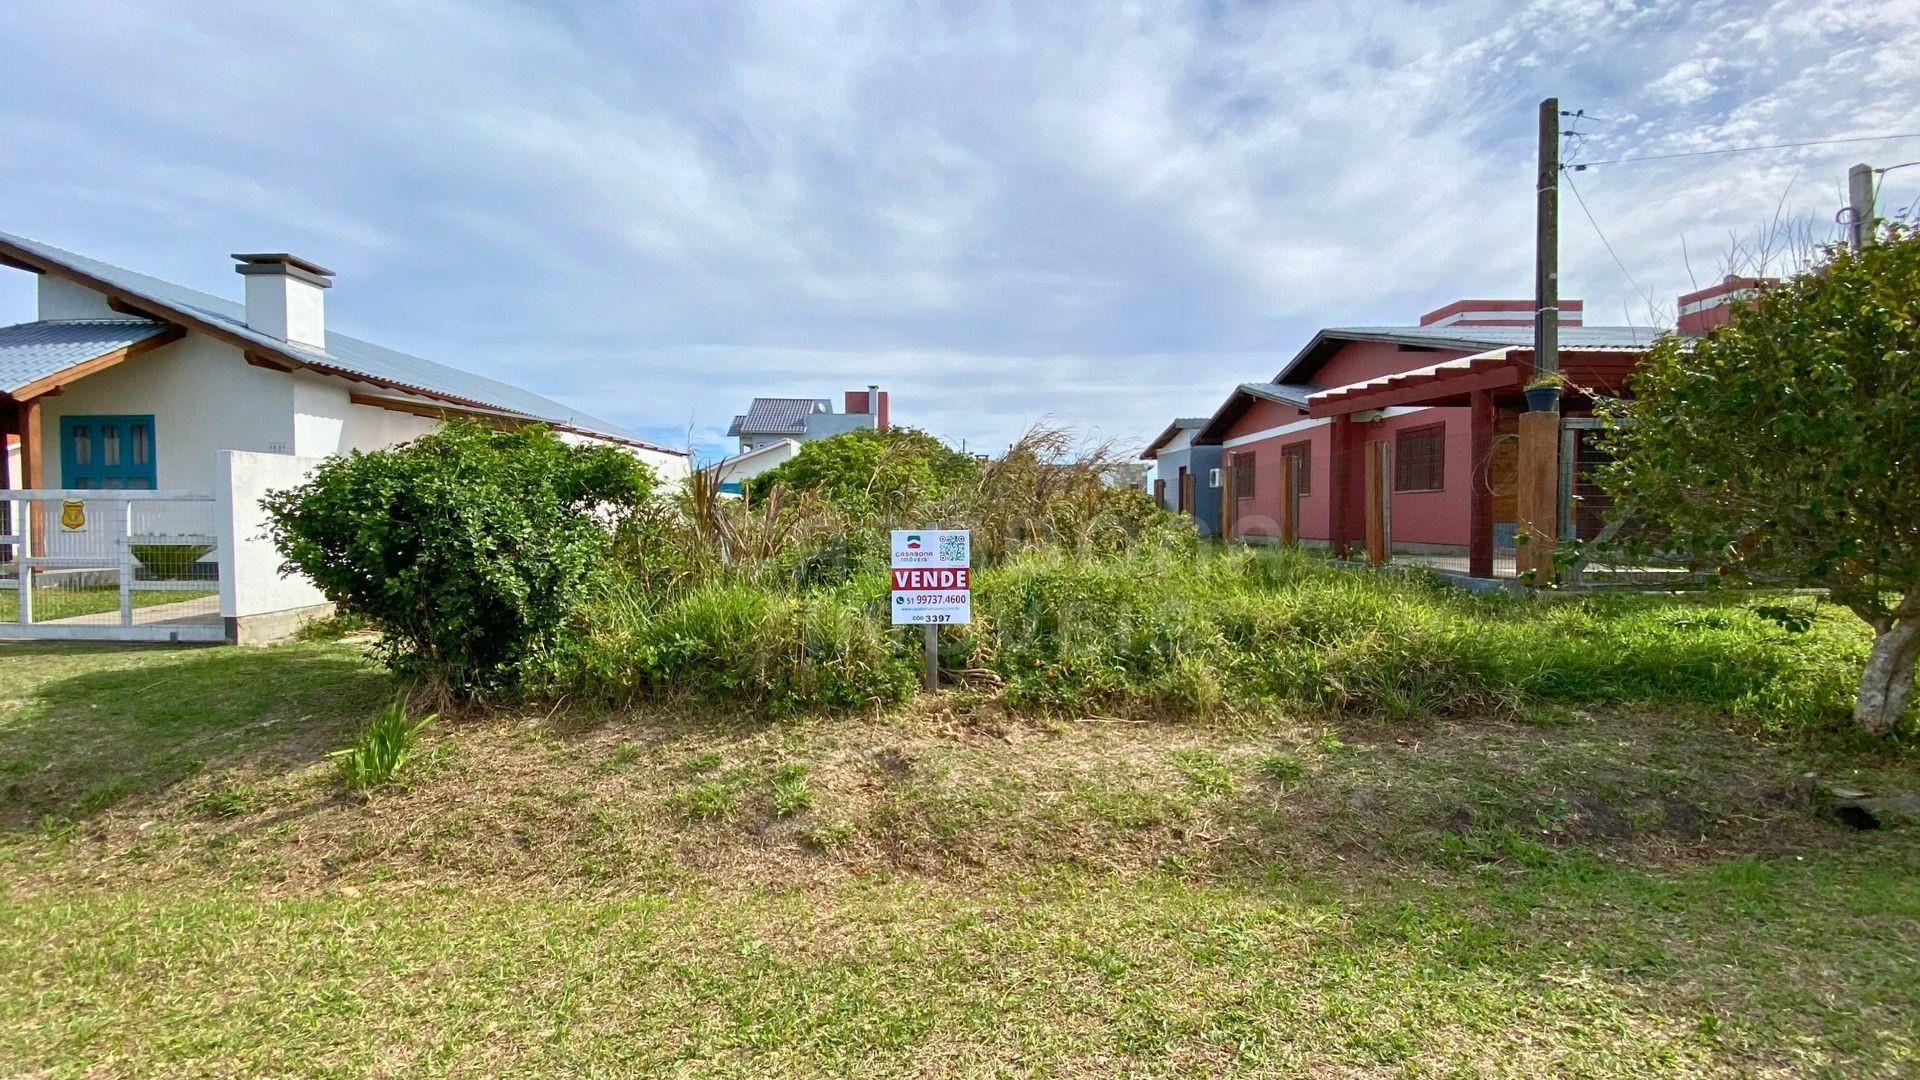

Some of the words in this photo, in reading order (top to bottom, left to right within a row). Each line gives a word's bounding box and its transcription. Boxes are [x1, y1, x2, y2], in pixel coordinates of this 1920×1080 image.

[895, 571, 966, 588] VENDE
[916, 595, 966, 604] 99737.4600
[925, 614, 951, 623] 3397
